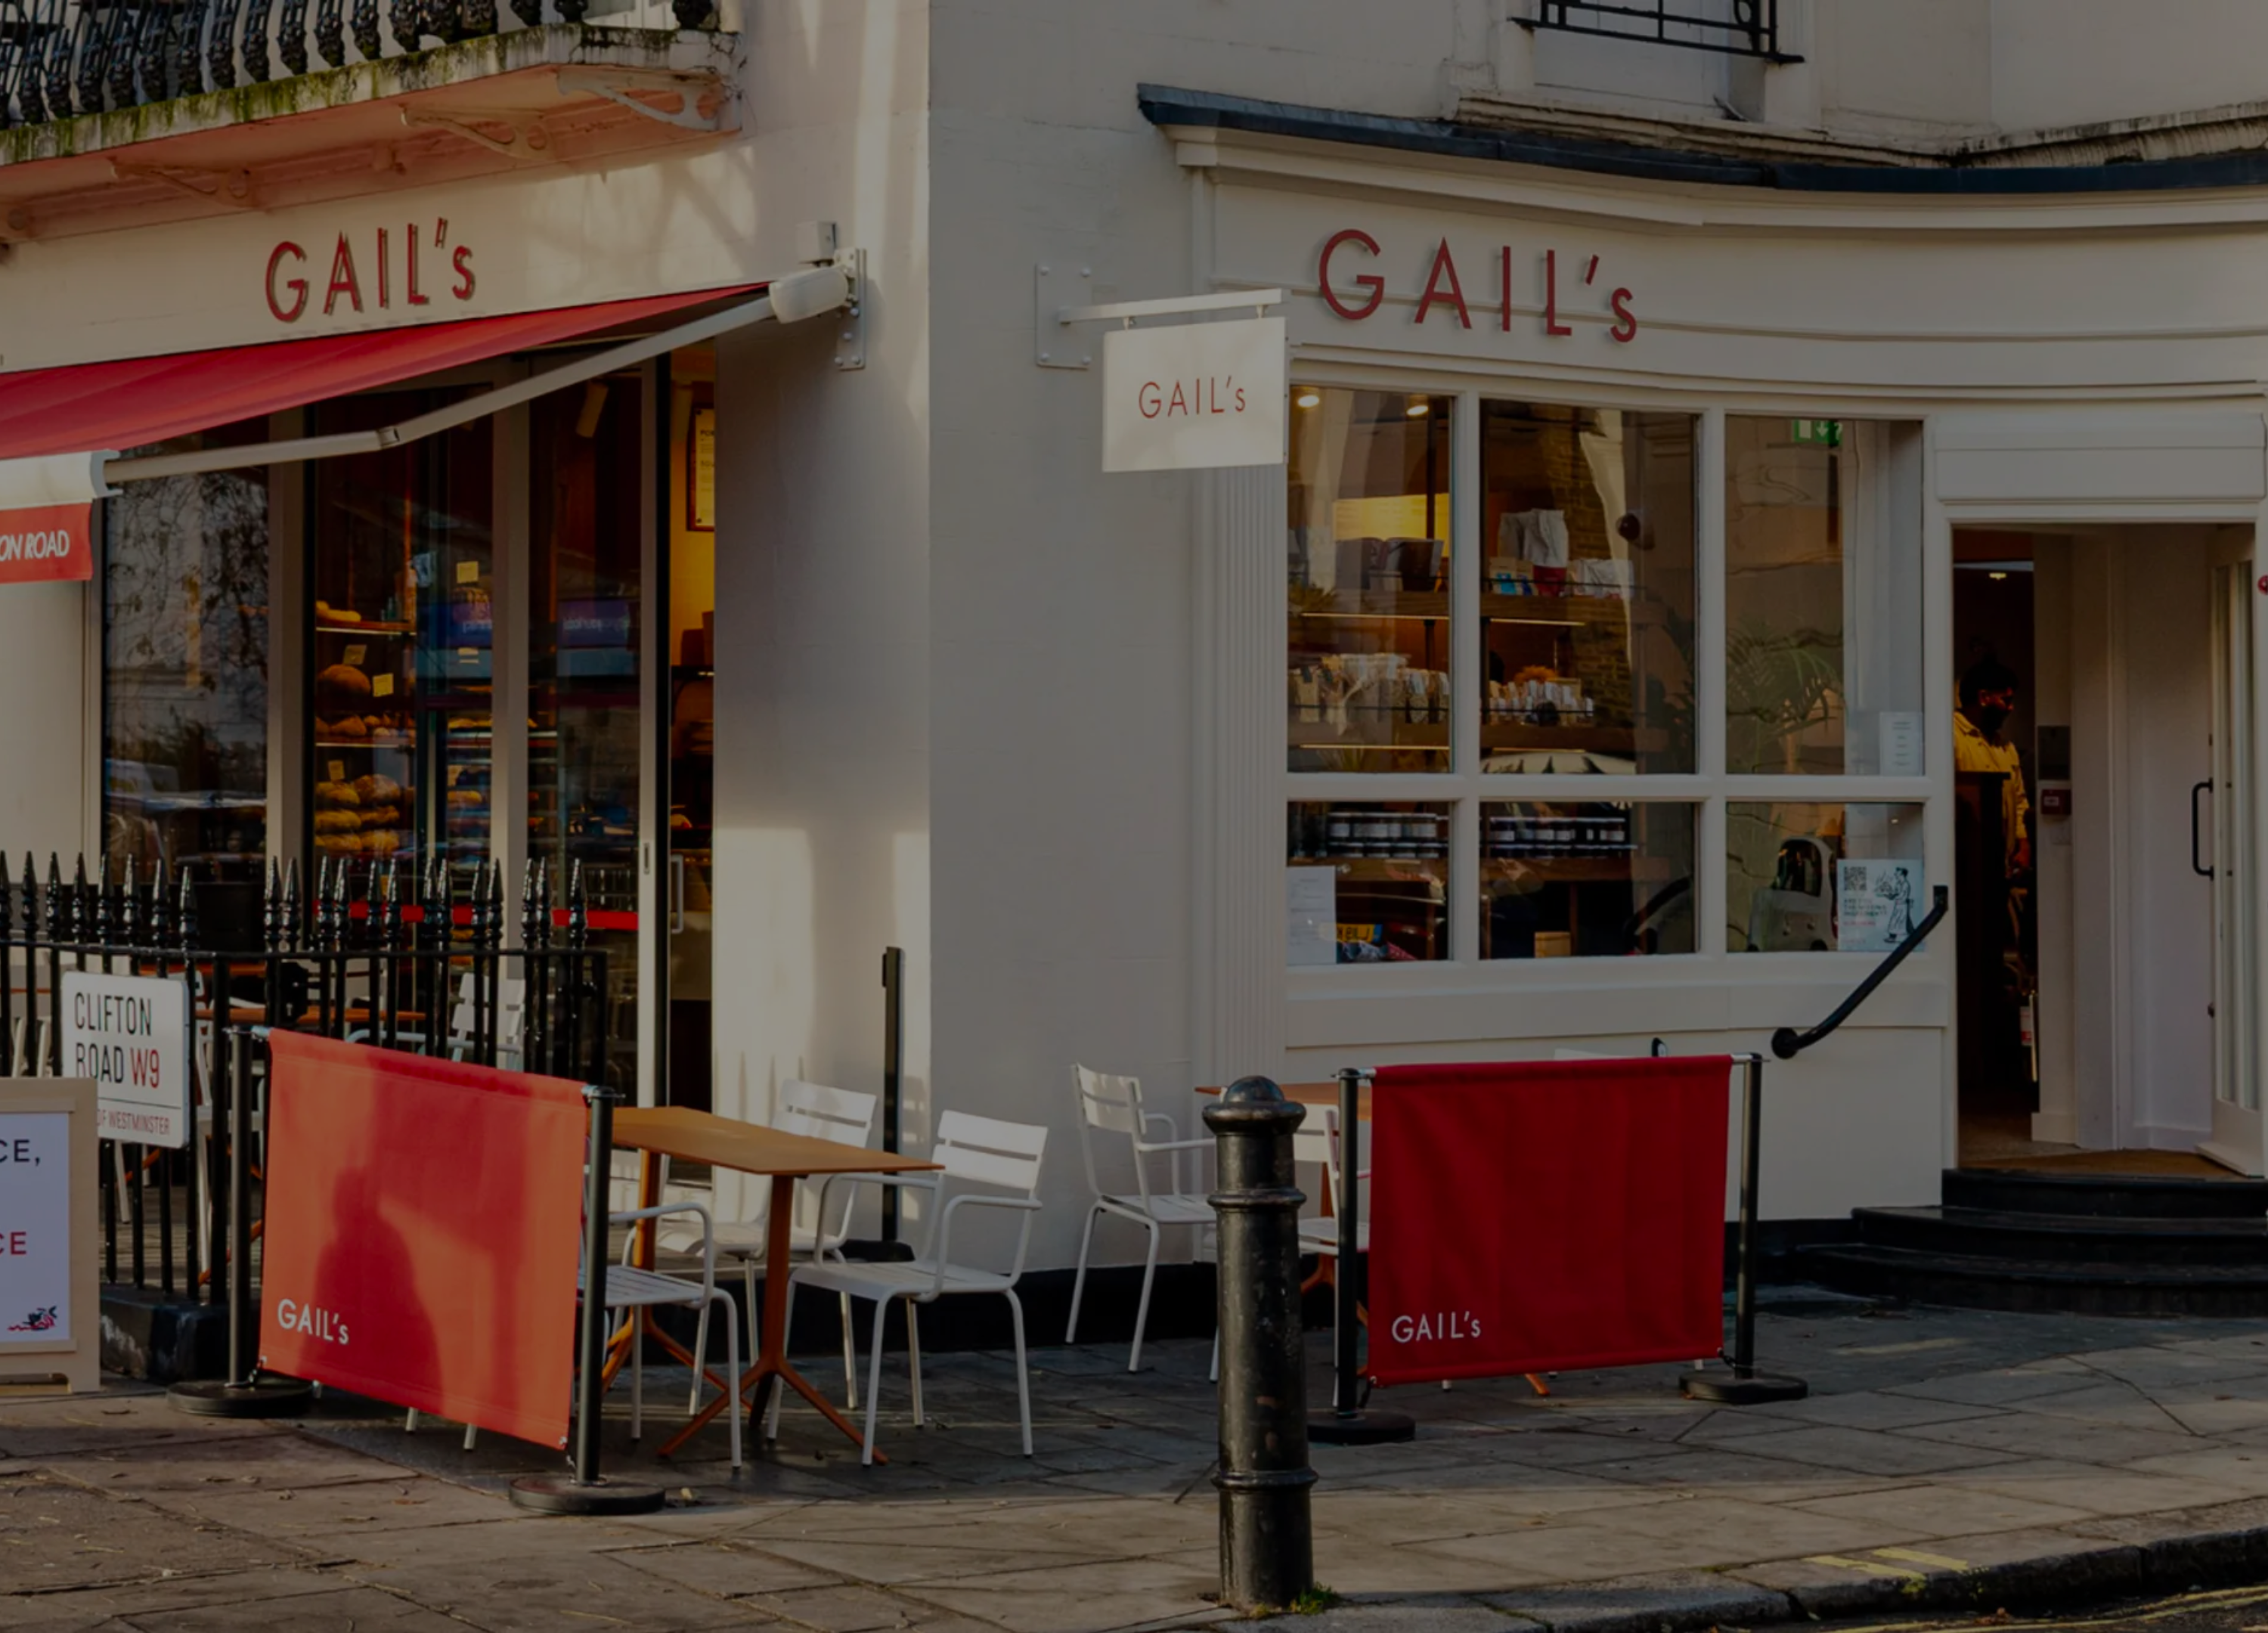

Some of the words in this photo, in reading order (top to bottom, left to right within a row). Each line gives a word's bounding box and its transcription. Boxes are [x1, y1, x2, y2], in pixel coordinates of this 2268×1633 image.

[265, 217, 476, 324] GAIL's
[1319, 229, 1637, 342] GAIL's
[1139, 376, 1246, 418] GAIL's
[24, 529, 70, 559] ROAD
[75, 992, 152, 1037] CLIFTON
[76, 1043, 124, 1083] ROAD
[130, 1047, 160, 1089] W9
[109, 1110, 171, 1136] WESTMINSTER
[0, 1232, 26, 1255] E
[277, 1298, 350, 1345] GAIL's
[1391, 1310, 1482, 1343] GAIL's
